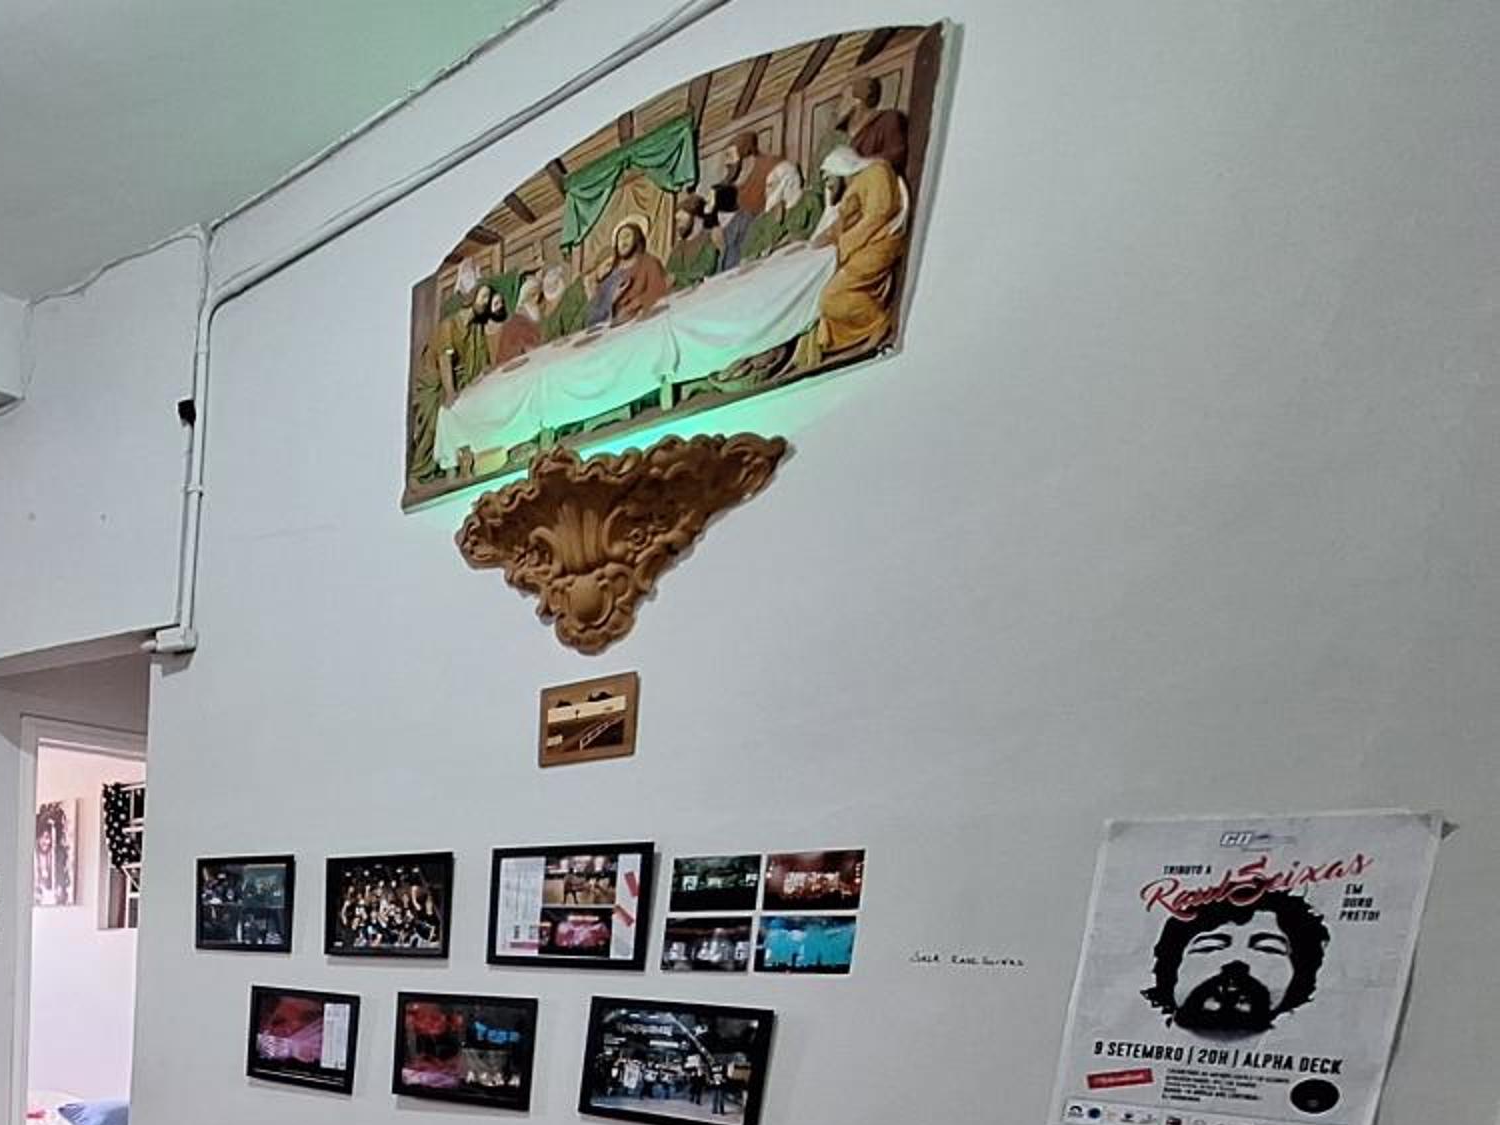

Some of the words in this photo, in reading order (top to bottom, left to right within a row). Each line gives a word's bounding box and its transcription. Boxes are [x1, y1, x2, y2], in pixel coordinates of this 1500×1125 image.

[1227, 851, 1374, 906] Seixas
[1345, 883, 1364, 895] EM
[1107, 1043, 1184, 1062] SETEMBRO
[1197, 1049, 1229, 1066] 20H
[1242, 1052, 1293, 1071] ALPHA
[1299, 1056, 1343, 1075] DECK
